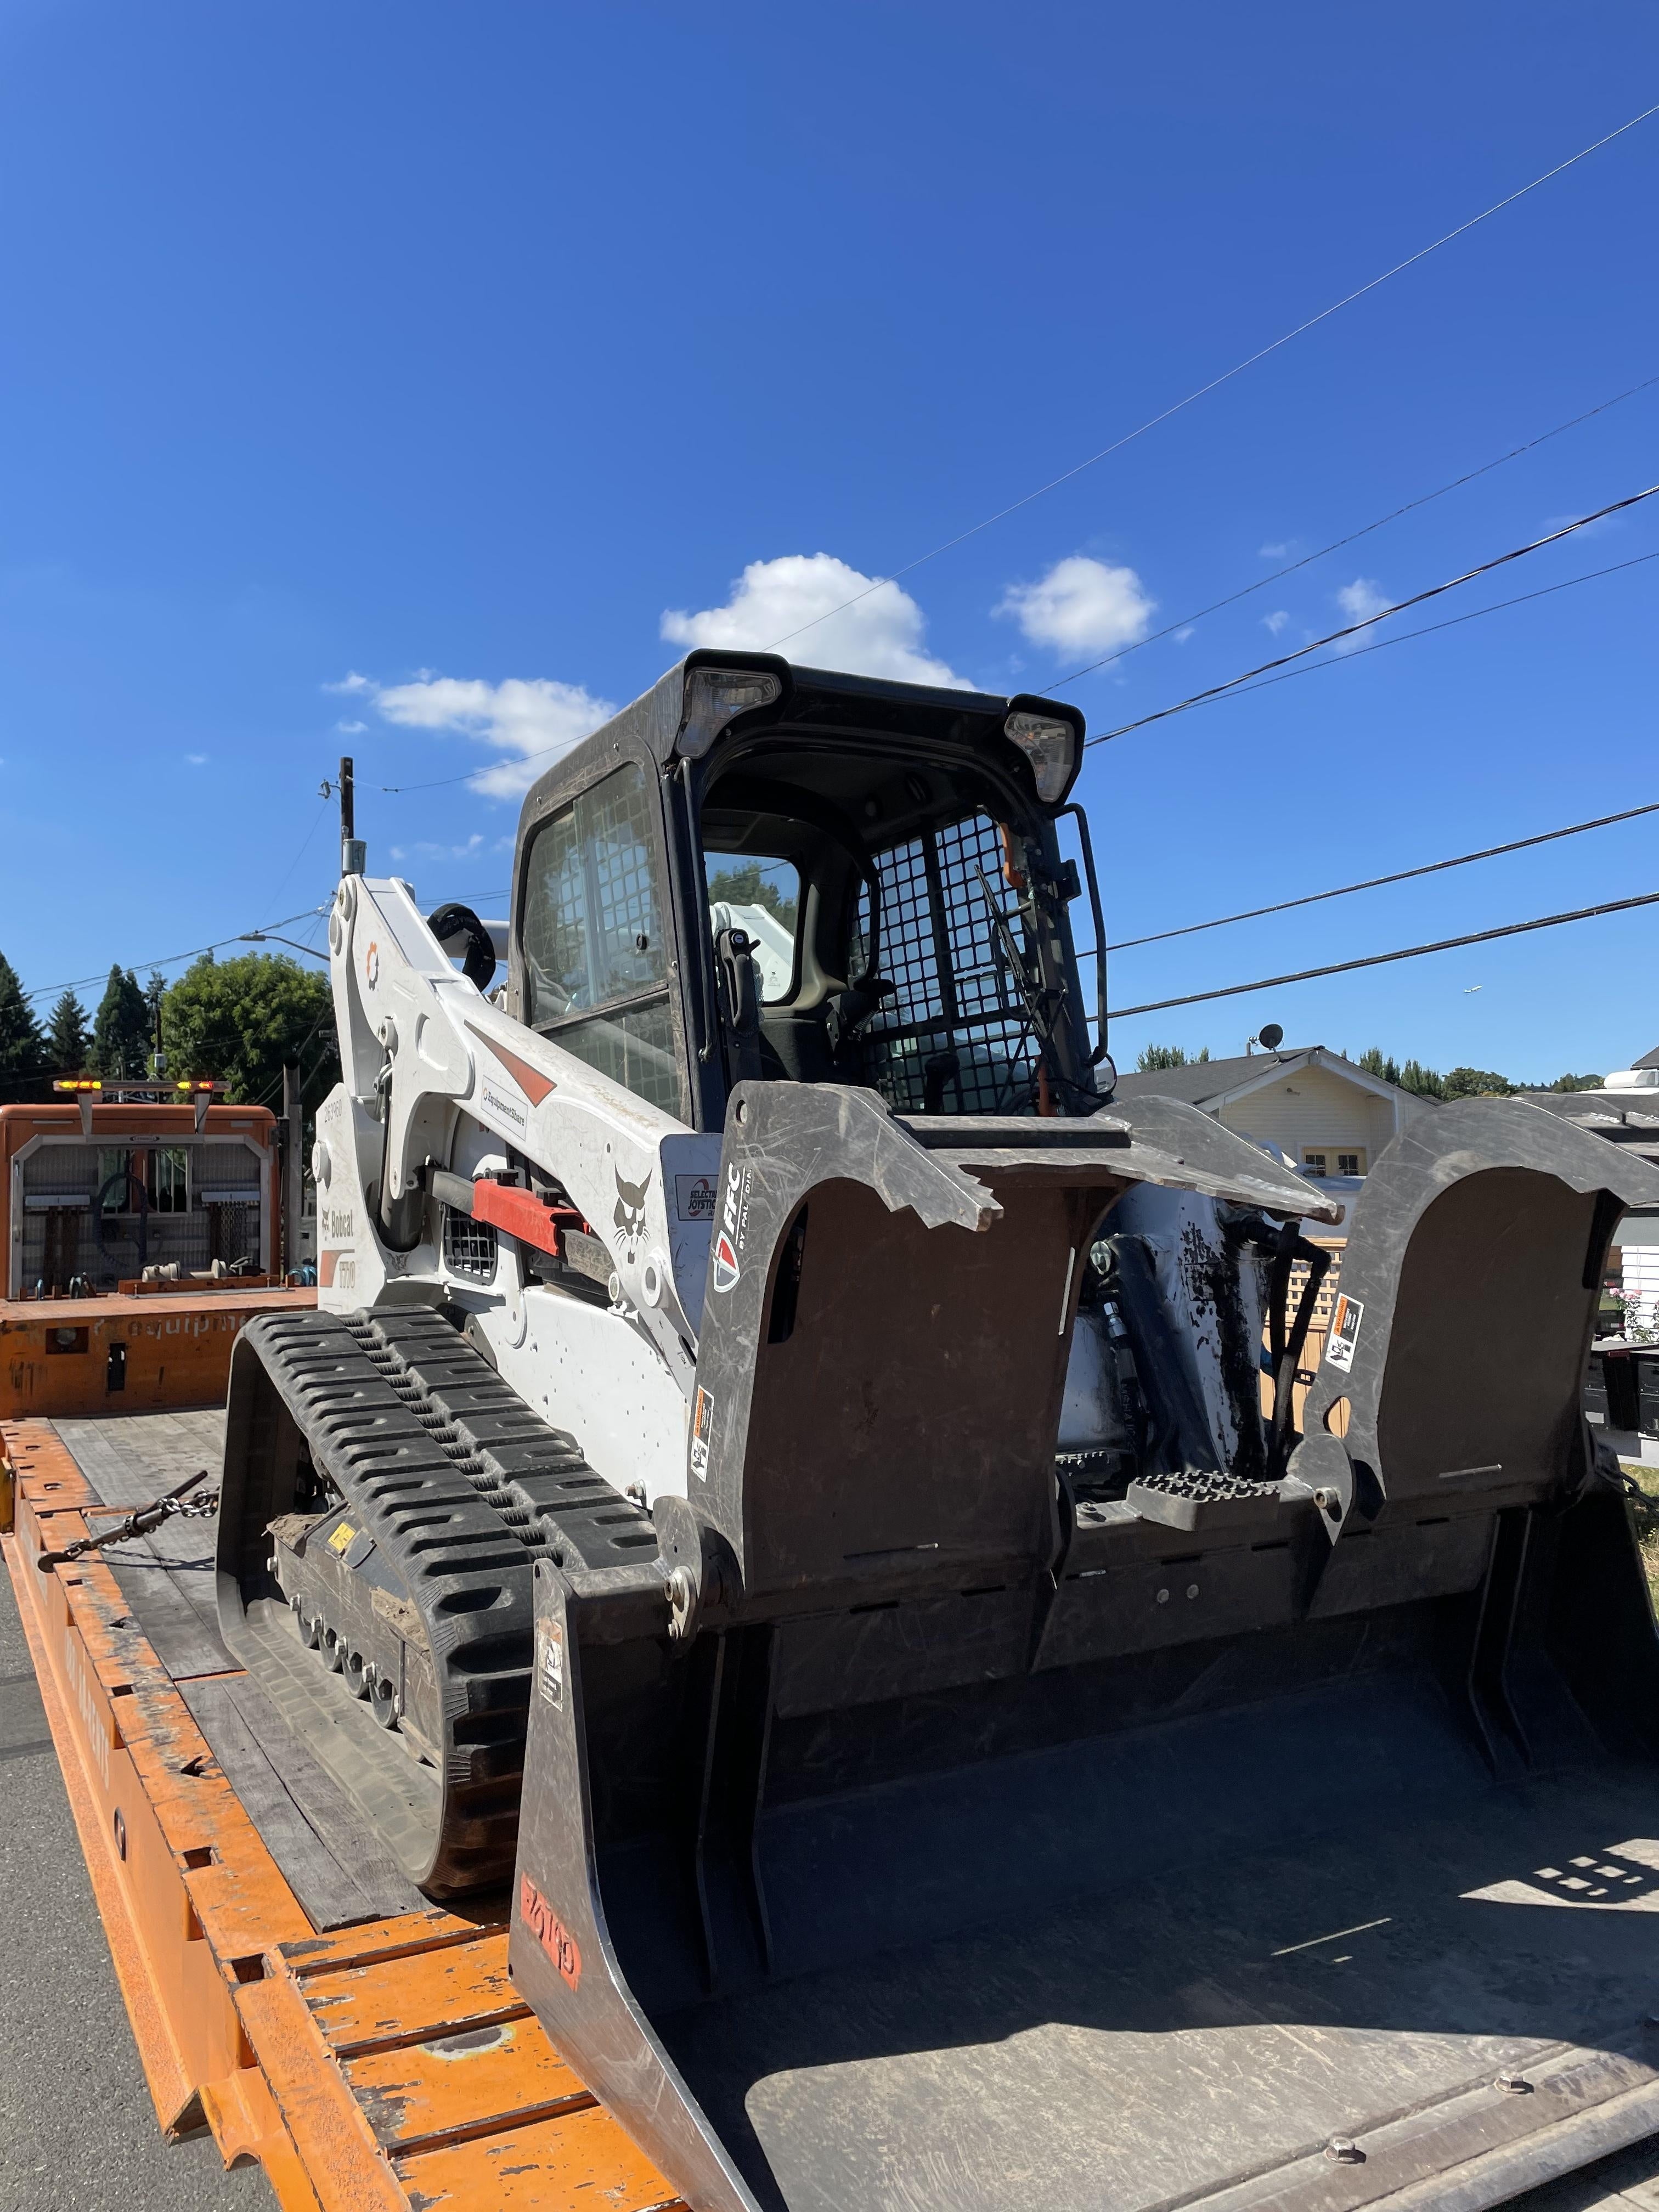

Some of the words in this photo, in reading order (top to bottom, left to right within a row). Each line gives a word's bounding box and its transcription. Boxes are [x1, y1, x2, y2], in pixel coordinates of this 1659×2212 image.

[488, 1091, 525, 1127] EquipmentShare
[724, 1162, 741, 1235] FFC
[331, 1209, 353, 1238] Bobcat
[739, 1231, 746, 1250] BY
